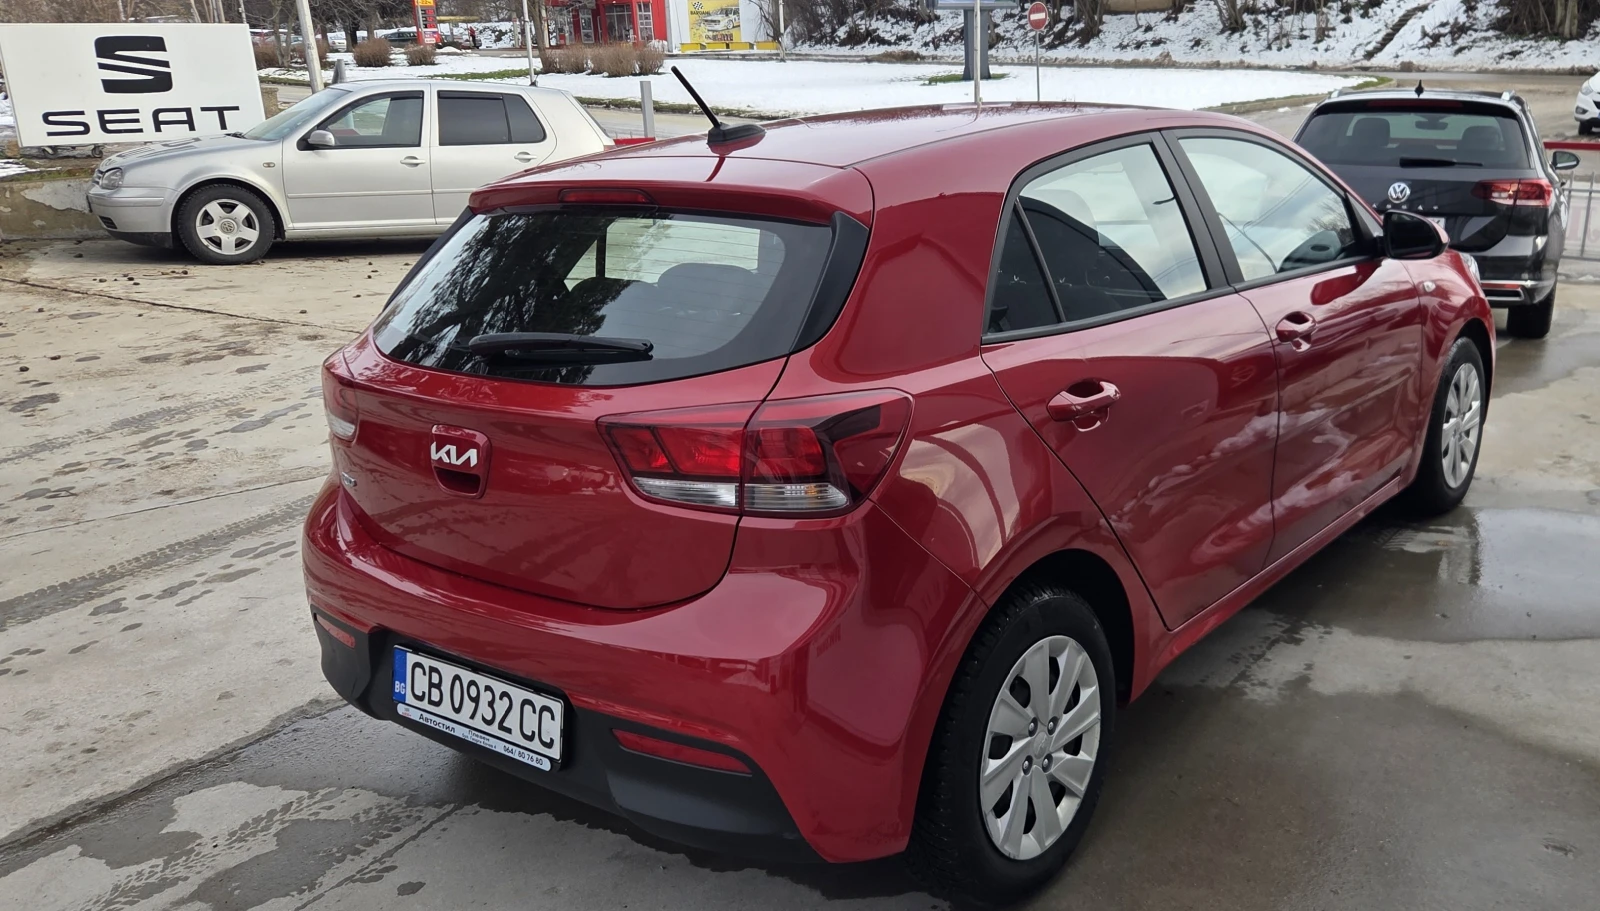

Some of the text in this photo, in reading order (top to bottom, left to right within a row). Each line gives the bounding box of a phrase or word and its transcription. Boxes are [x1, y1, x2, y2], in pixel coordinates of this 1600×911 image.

[42, 106, 240, 137] SEAT
[430, 441, 478, 468] KIA
[394, 680, 406, 694] BG
[450, 674, 513, 735] 0932
[419, 713, 456, 733] Автостил
[468, 729, 490, 742] Плевен
